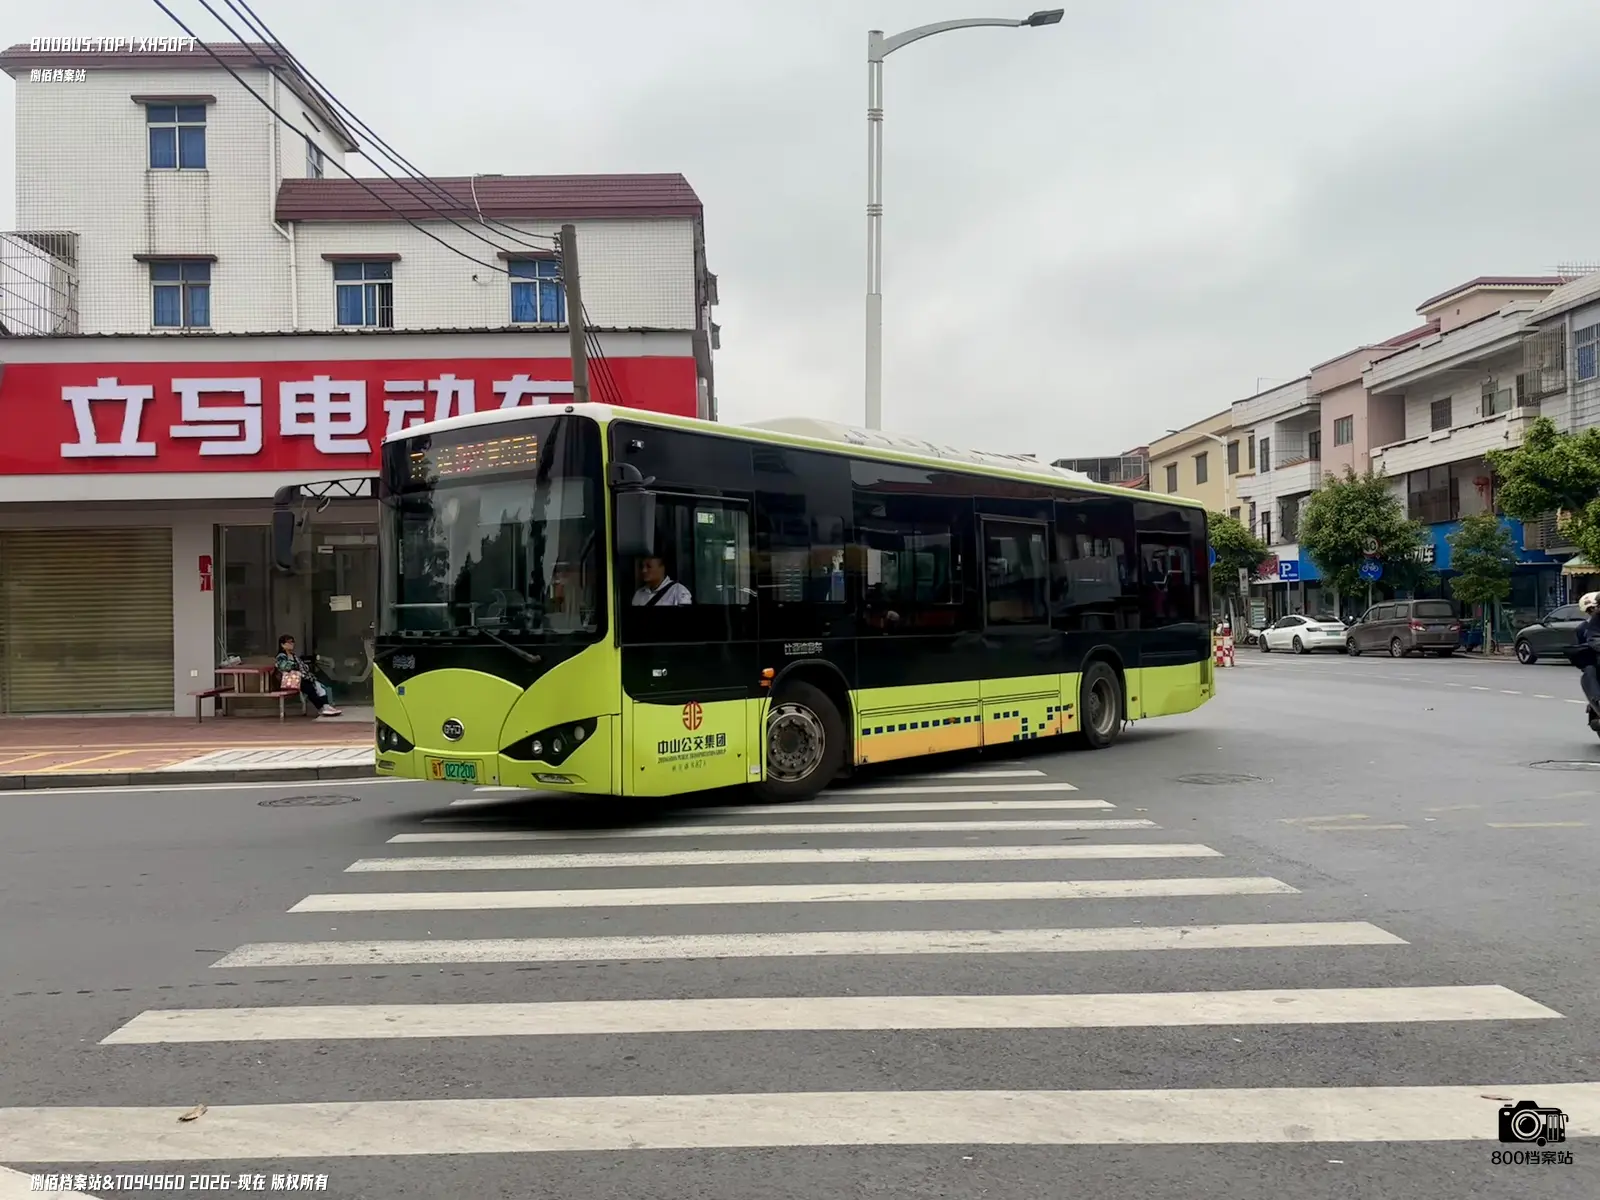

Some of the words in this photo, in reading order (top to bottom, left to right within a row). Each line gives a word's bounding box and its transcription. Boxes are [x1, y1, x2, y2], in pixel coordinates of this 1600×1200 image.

[1280, 563, 1292, 578] P
[444, 724, 461, 735] BYD
[657, 732, 726, 755] 中山公交集团
